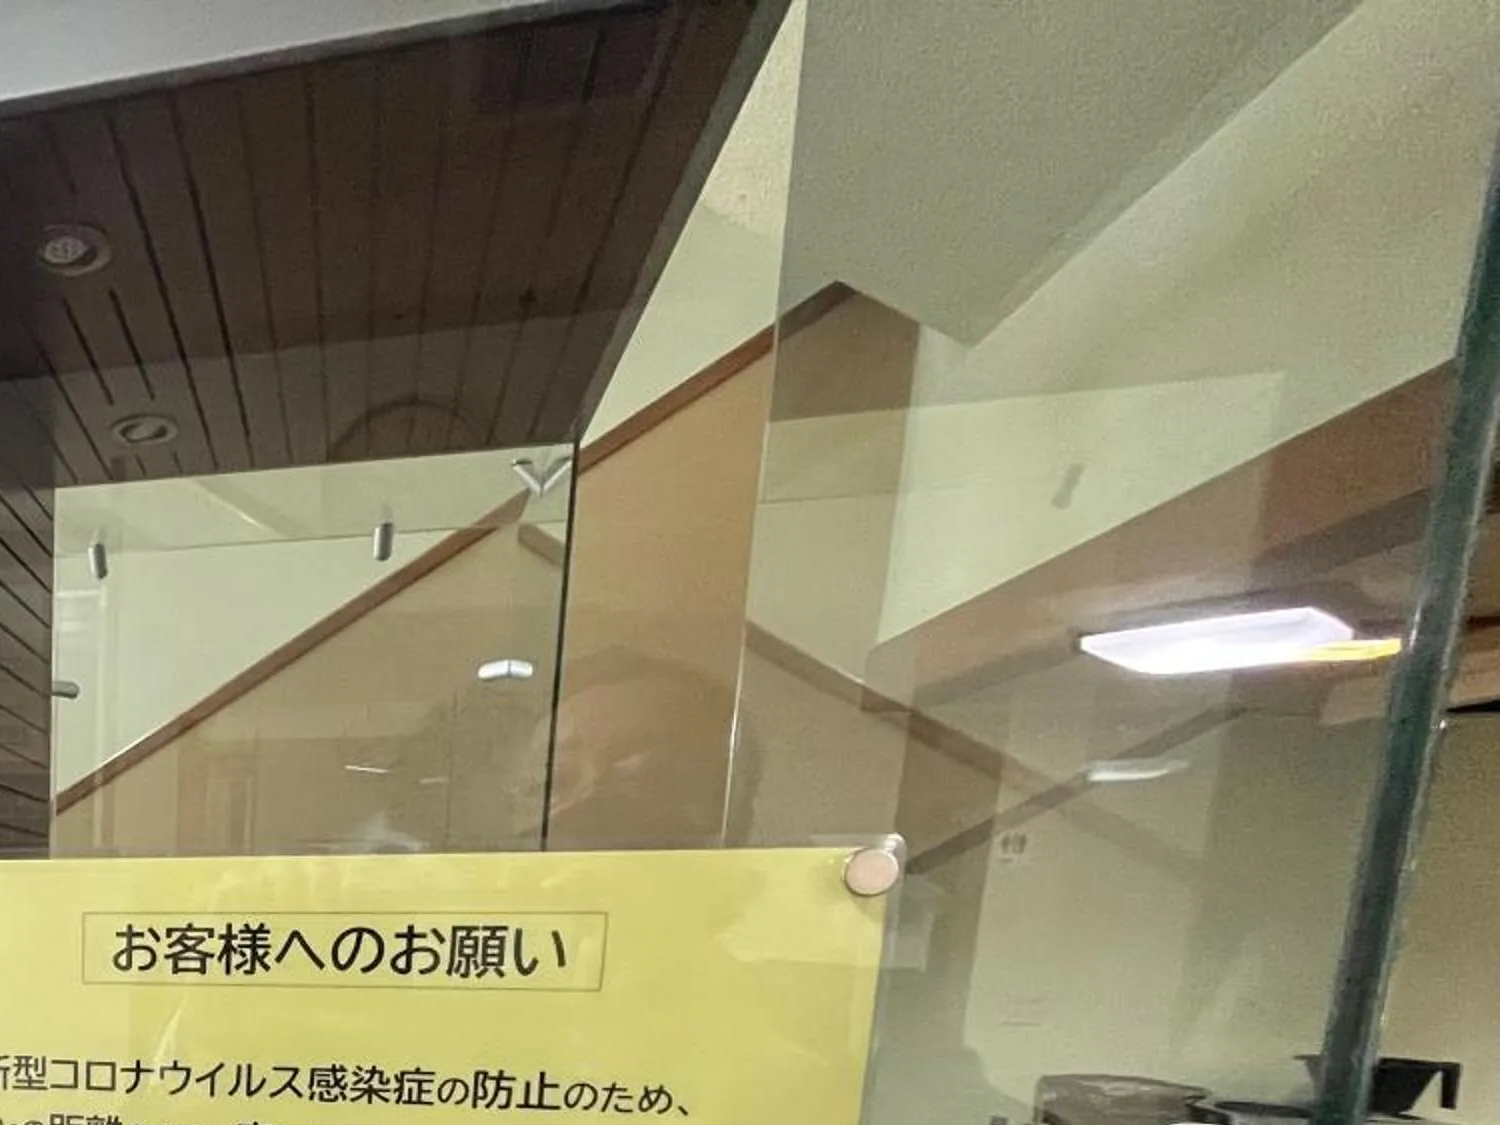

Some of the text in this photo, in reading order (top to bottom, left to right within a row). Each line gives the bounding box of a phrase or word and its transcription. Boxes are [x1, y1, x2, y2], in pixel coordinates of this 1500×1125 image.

[111, 922, 567, 979] お客様へのお願い
